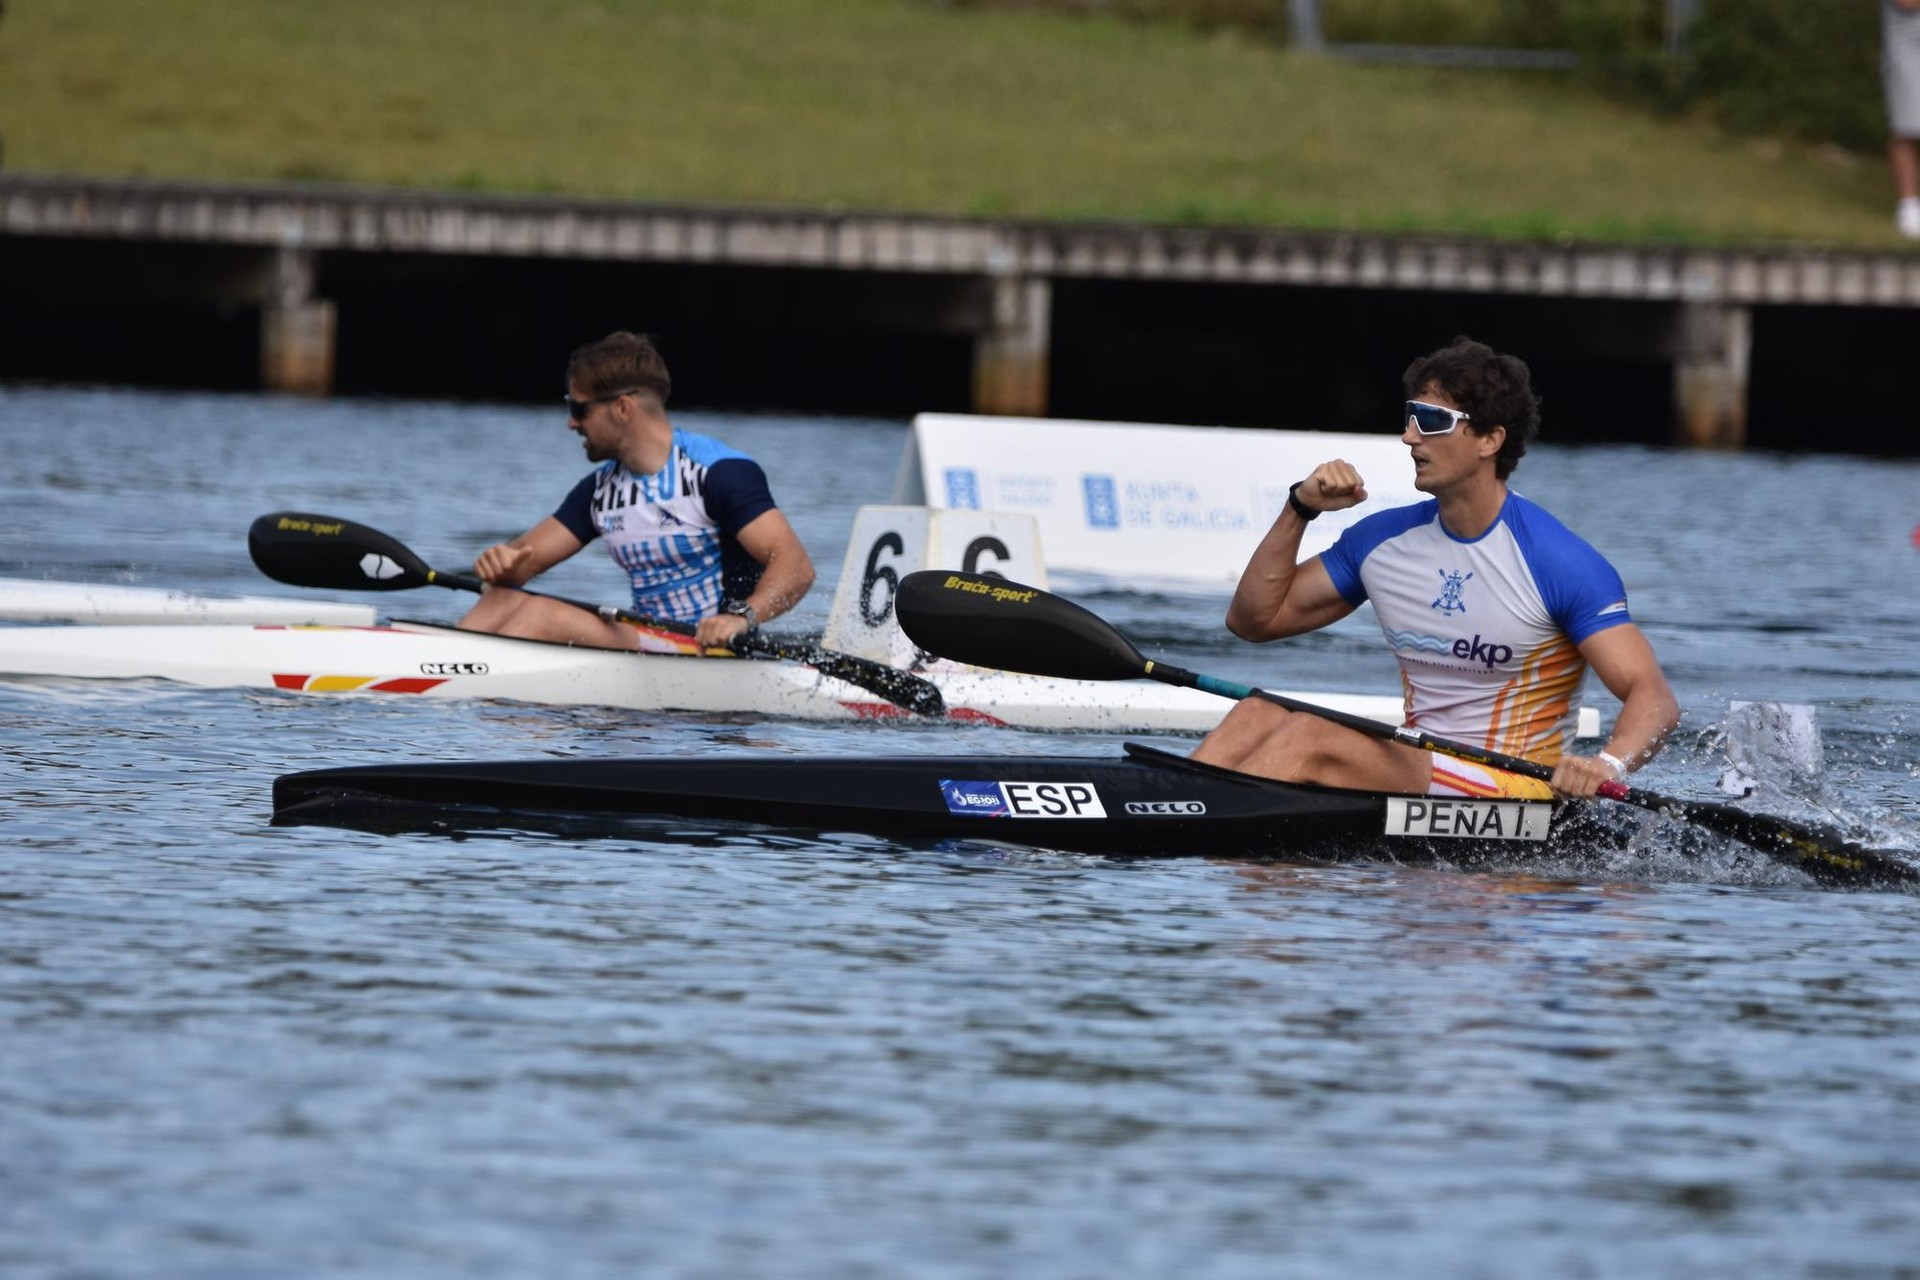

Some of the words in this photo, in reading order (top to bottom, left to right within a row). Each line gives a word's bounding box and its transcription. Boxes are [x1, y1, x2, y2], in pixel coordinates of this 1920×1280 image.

[859, 531, 904, 628] 6
[1452, 634, 1513, 668] ekp
[421, 662, 489, 675] NELO
[1004, 784, 1093, 815] ESP
[1127, 802, 1204, 814] NELO
[1403, 800, 1504, 837] PEÑA
